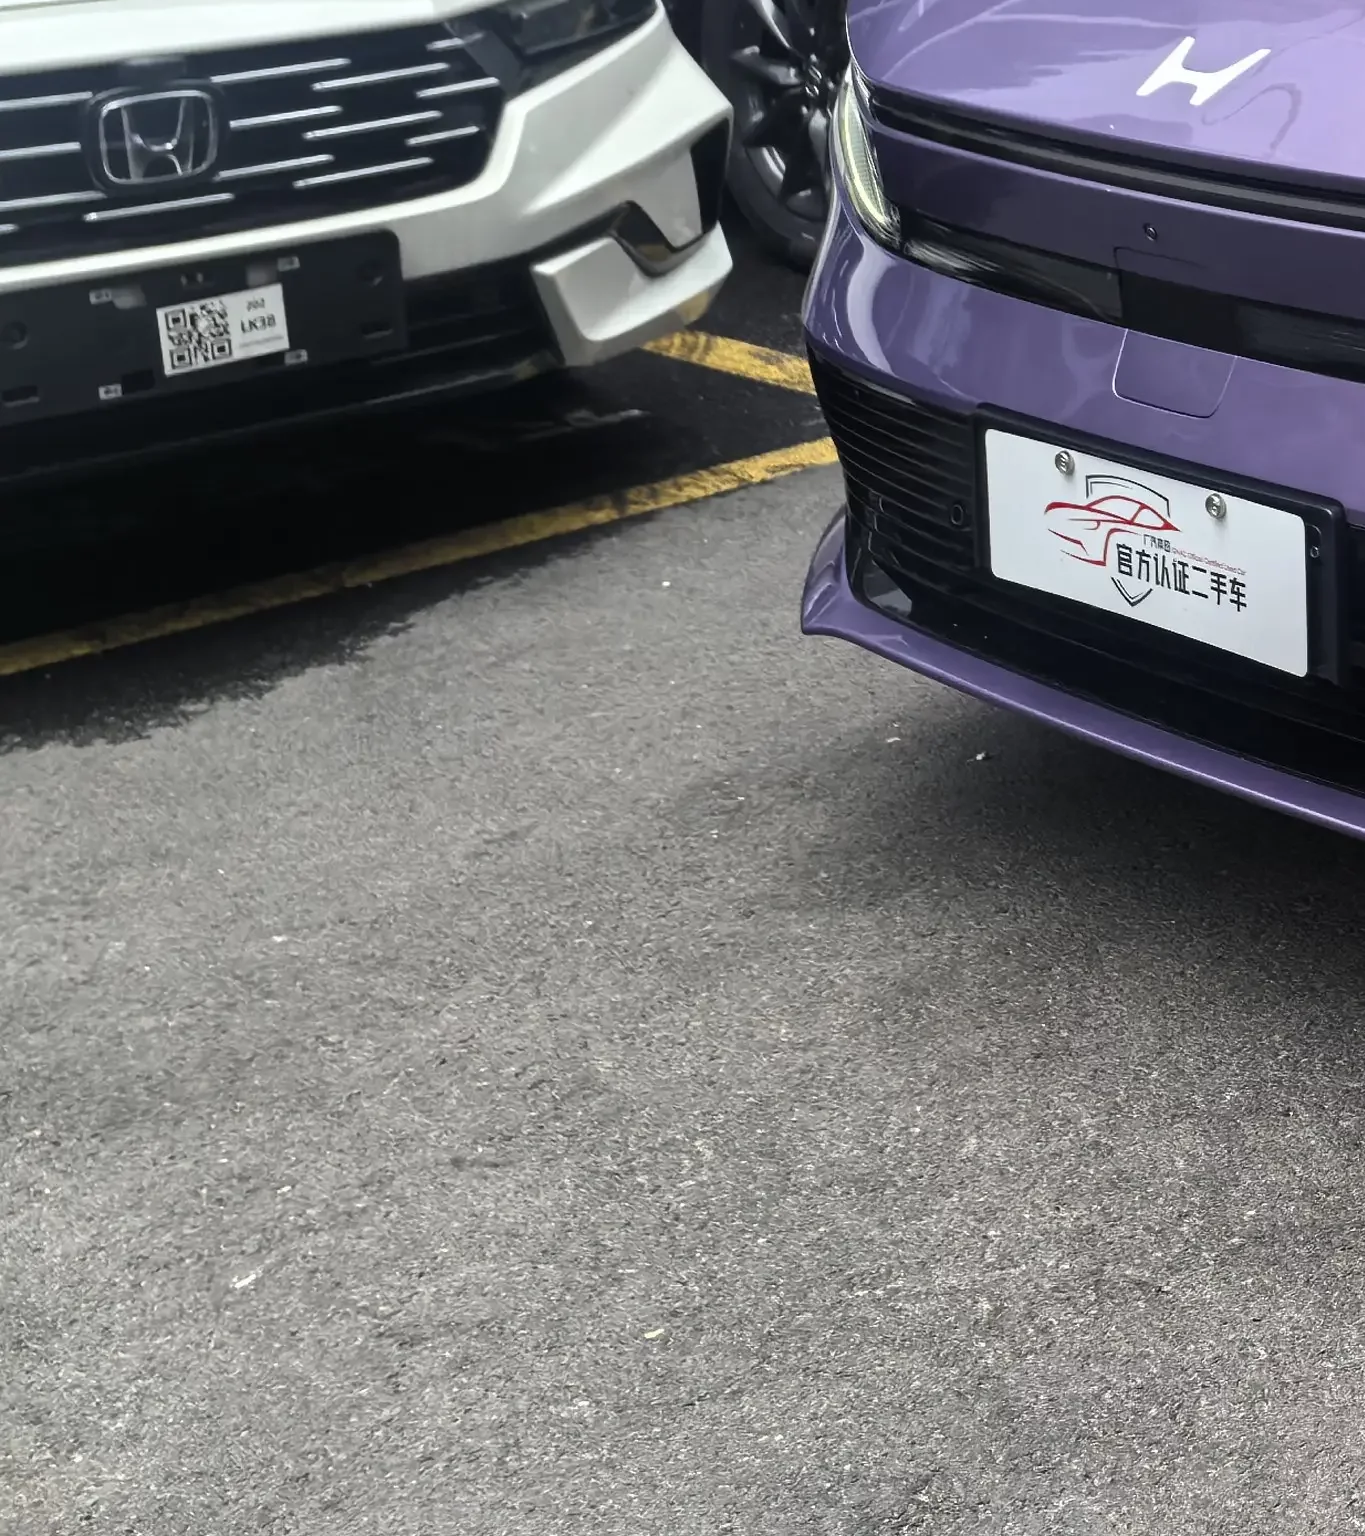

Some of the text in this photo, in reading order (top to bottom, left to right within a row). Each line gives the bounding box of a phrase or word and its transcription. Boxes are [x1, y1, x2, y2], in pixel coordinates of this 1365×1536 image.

[1116, 542, 1247, 612] 官方认证二手车
